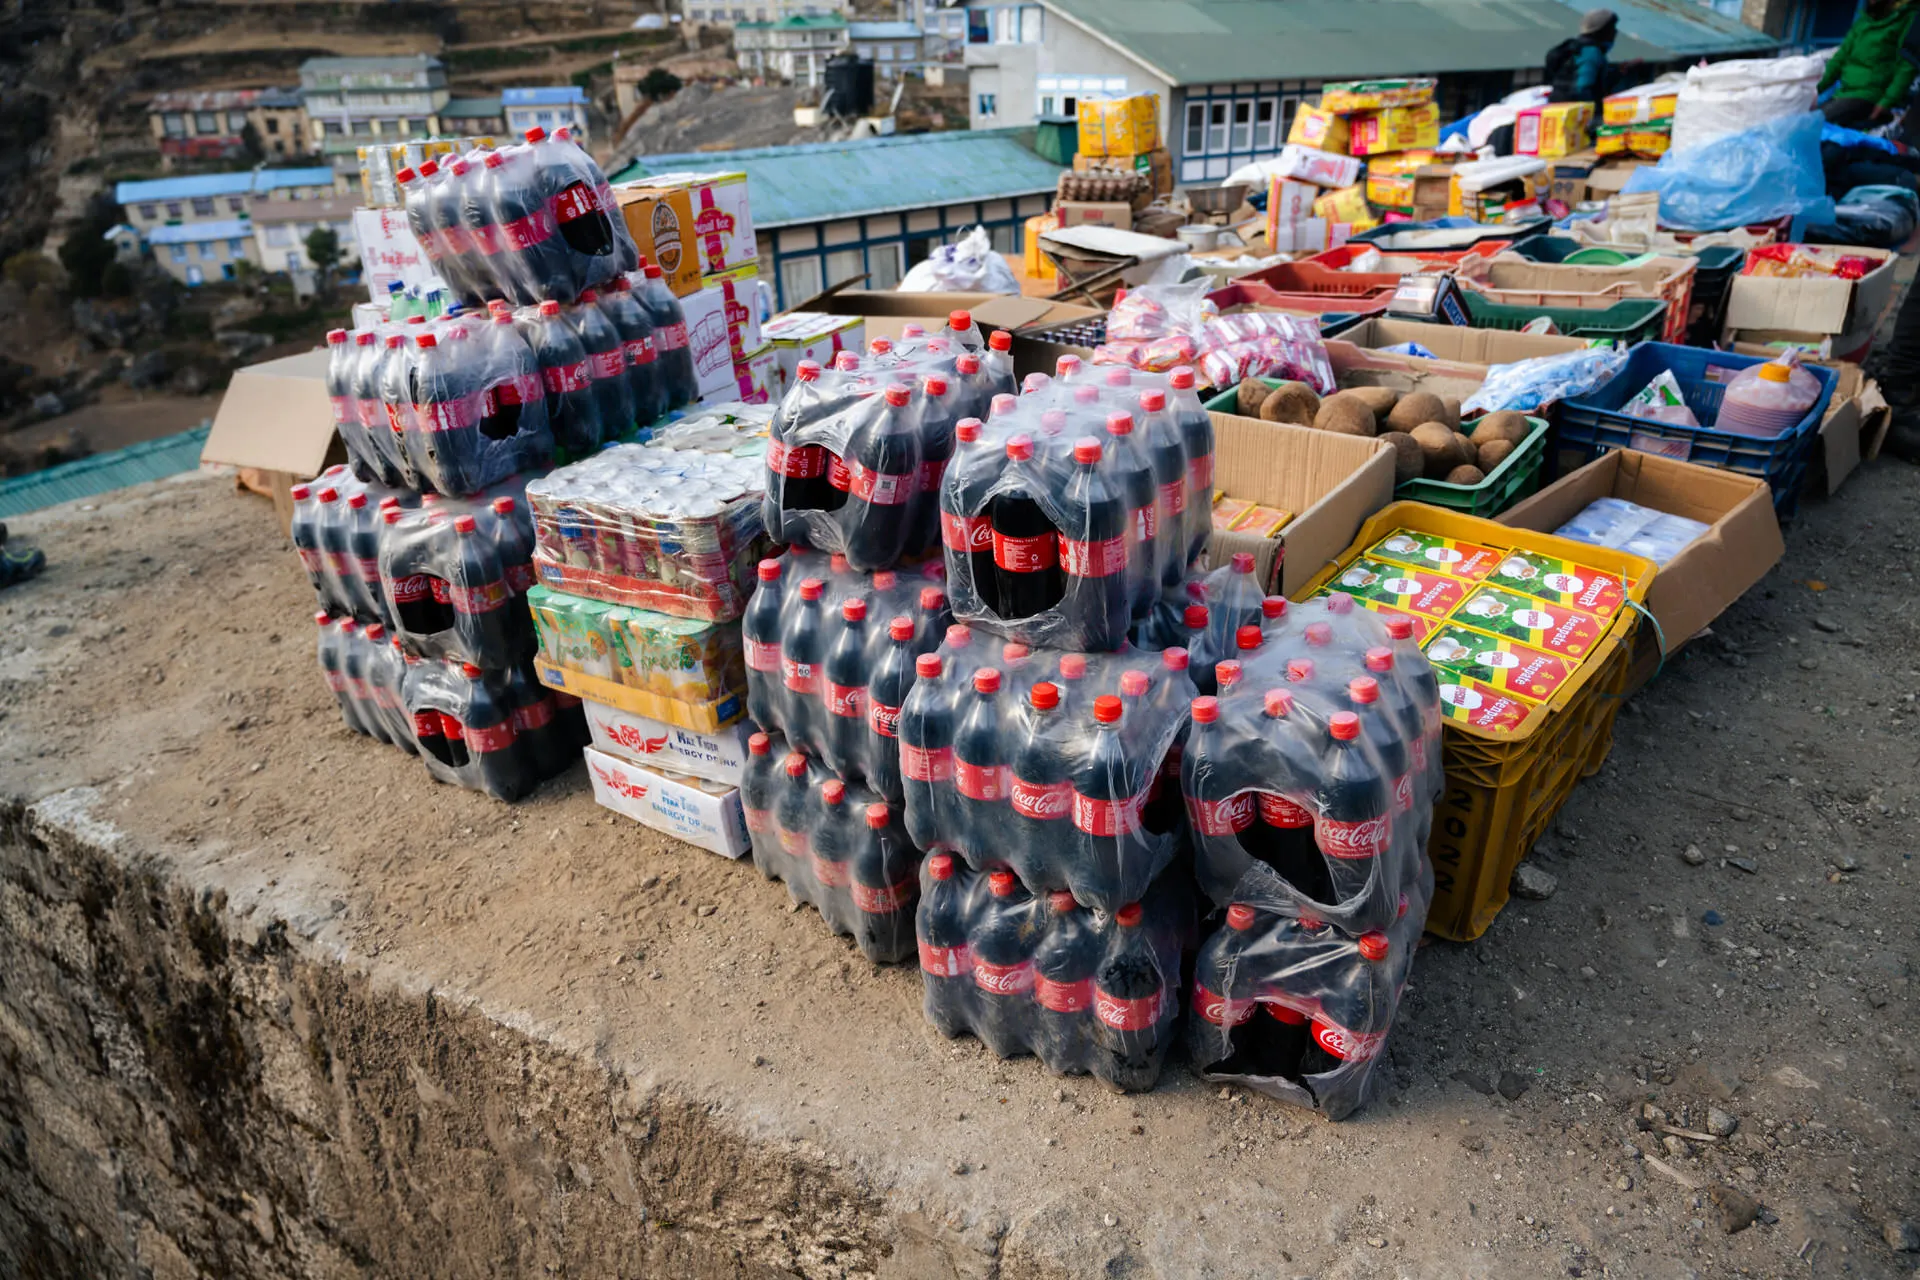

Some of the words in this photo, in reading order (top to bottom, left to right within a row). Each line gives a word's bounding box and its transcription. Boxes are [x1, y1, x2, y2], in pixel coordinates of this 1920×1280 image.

[1551, 615, 1586, 646] Teenpate
[1515, 657, 1552, 685] Teenpate
[1476, 697, 1517, 725] Teenpate
[1320, 817, 1385, 847] Coca-Cola
